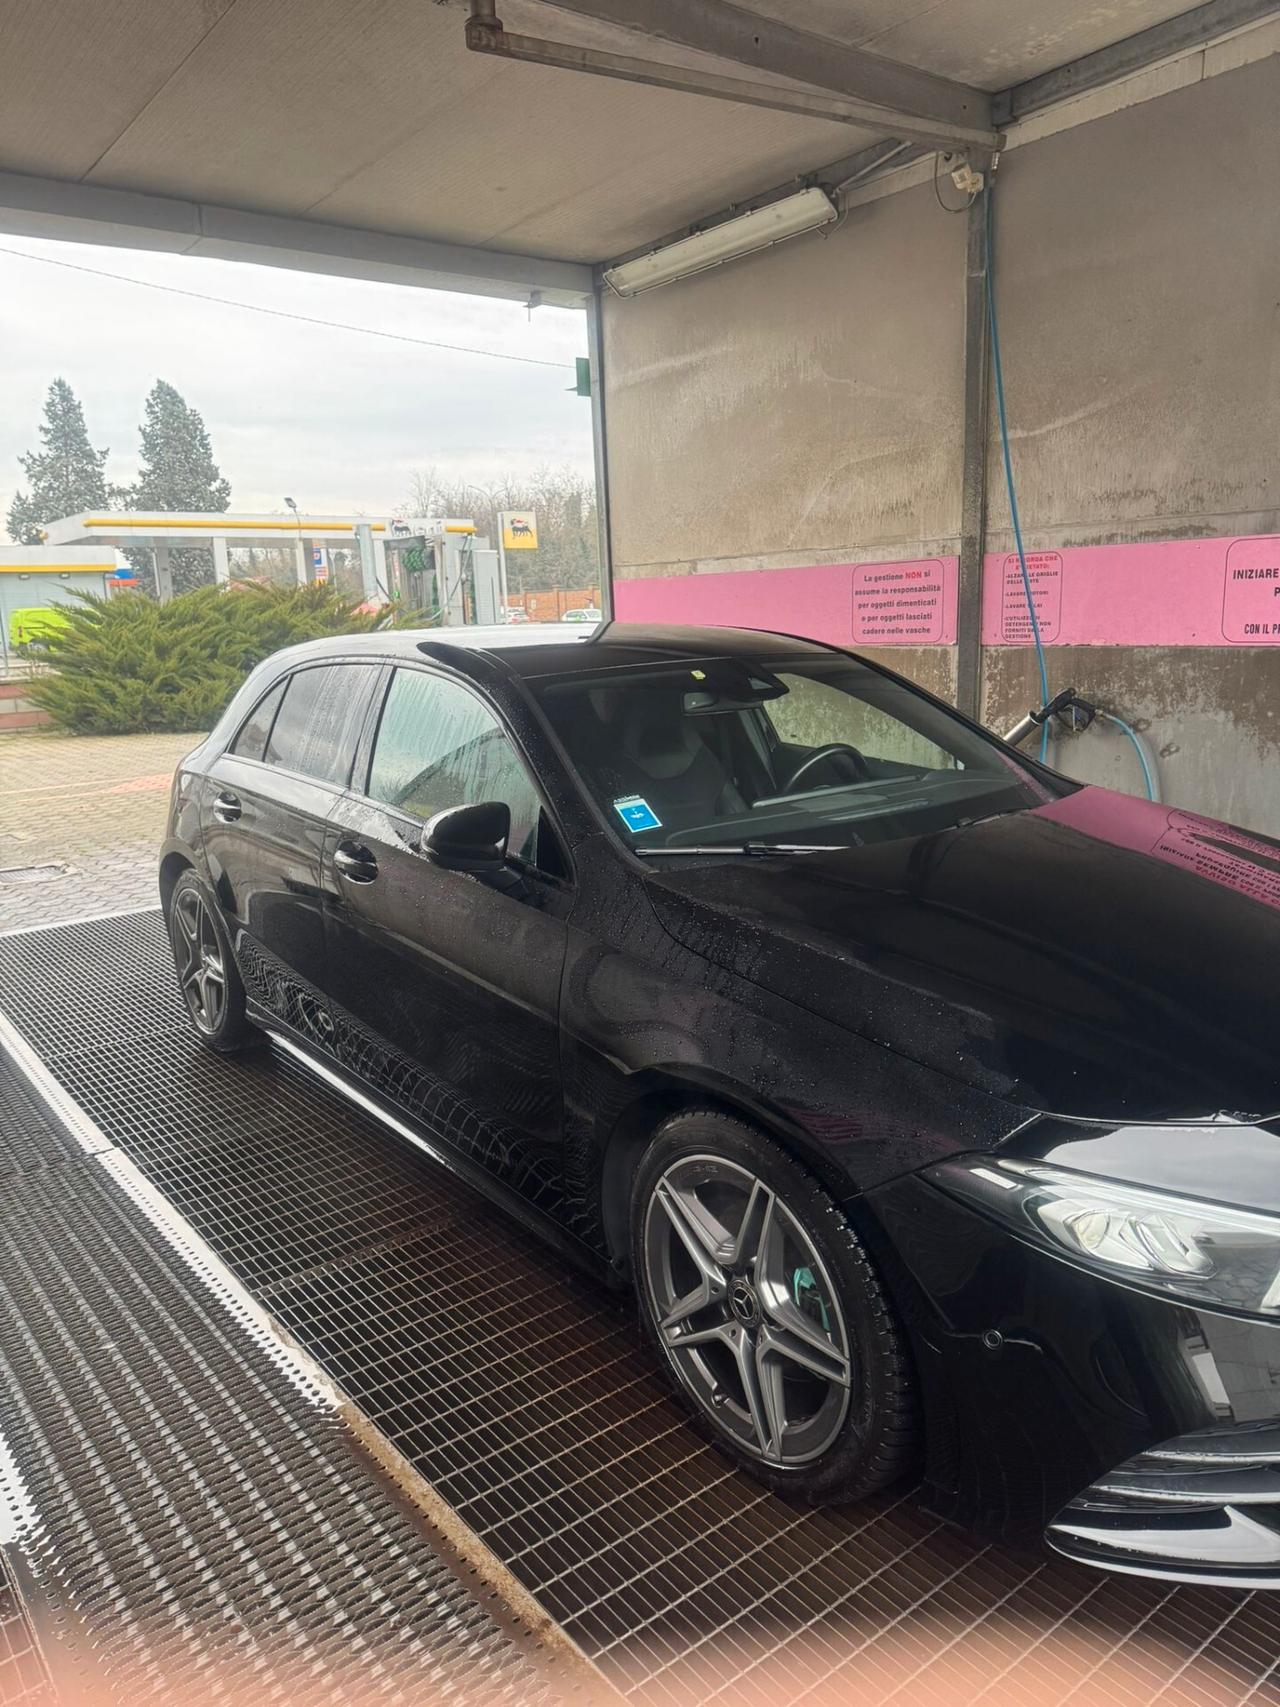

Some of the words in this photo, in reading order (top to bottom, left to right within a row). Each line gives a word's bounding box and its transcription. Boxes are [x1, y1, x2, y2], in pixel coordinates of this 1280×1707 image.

[874, 573, 904, 583] gestione
[1233, 568, 1280, 580] INIZIARE
[890, 584, 942, 594] responsabilità
[870, 600, 894, 609] oggetti
[896, 598, 936, 608] dimenticati
[880, 613, 904, 622] oggetti
[906, 612, 932, 620] lasciati
[1244, 624, 1260, 634] CON
[1262, 624, 1269, 634] IL
